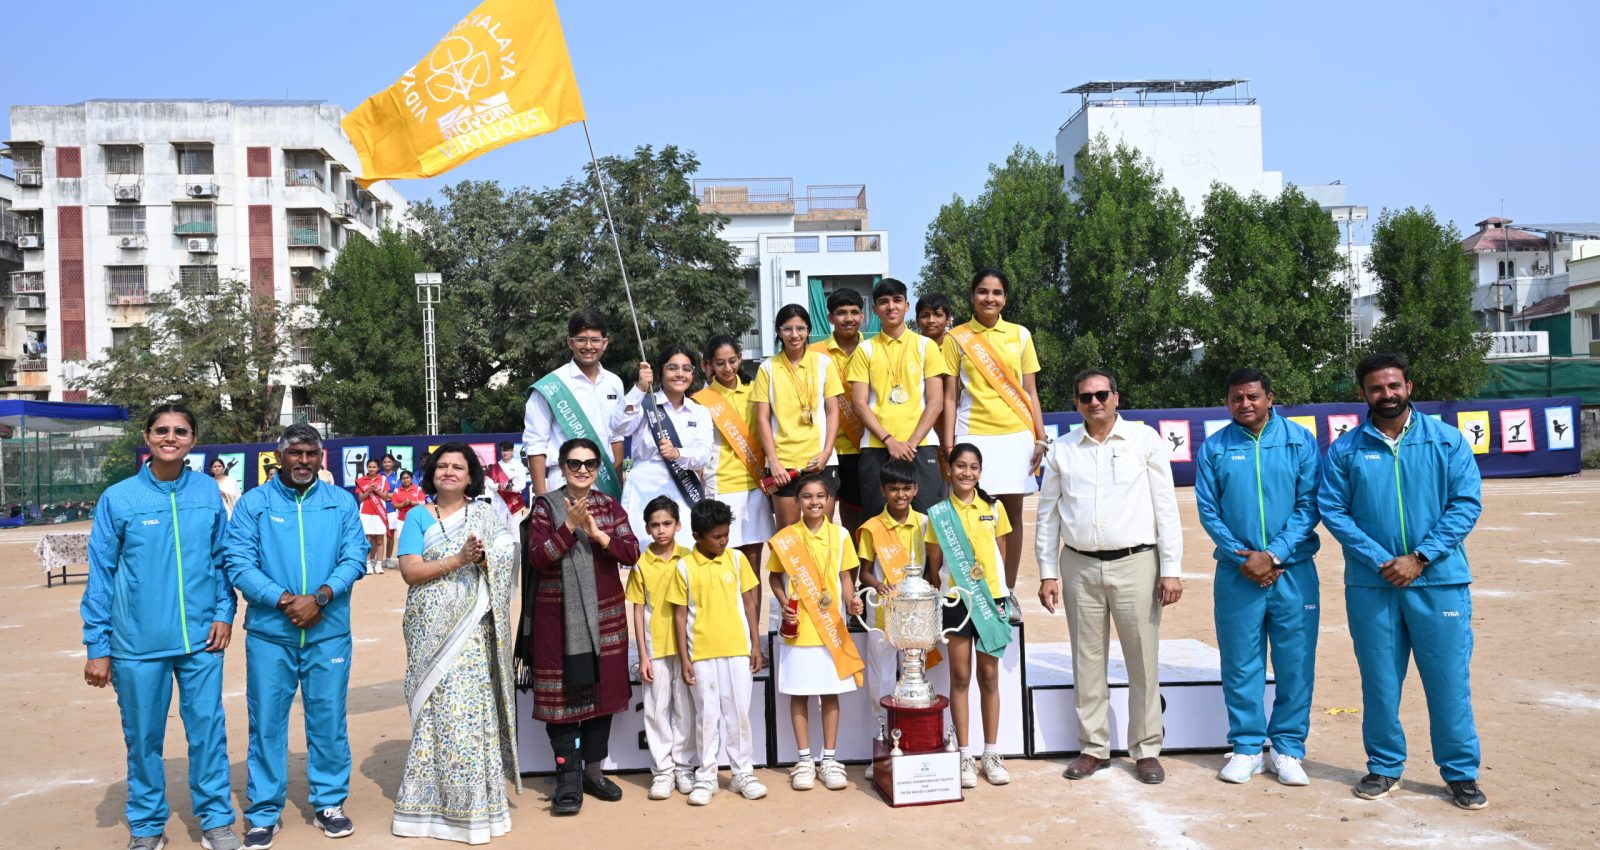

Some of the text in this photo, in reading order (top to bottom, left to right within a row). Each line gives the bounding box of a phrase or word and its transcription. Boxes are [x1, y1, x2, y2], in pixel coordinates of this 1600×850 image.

[438, 108, 540, 160] VIRTUOUS
[971, 343, 1004, 381] PREFECT
[838, 394, 858, 423] REFECT
[723, 418, 740, 439] VICE
[1364, 453, 1380, 461] TYKA
[269, 515, 285, 523] TYKA
[943, 526, 966, 561] SECRETARY
[975, 593, 993, 620] AFFAIRS
